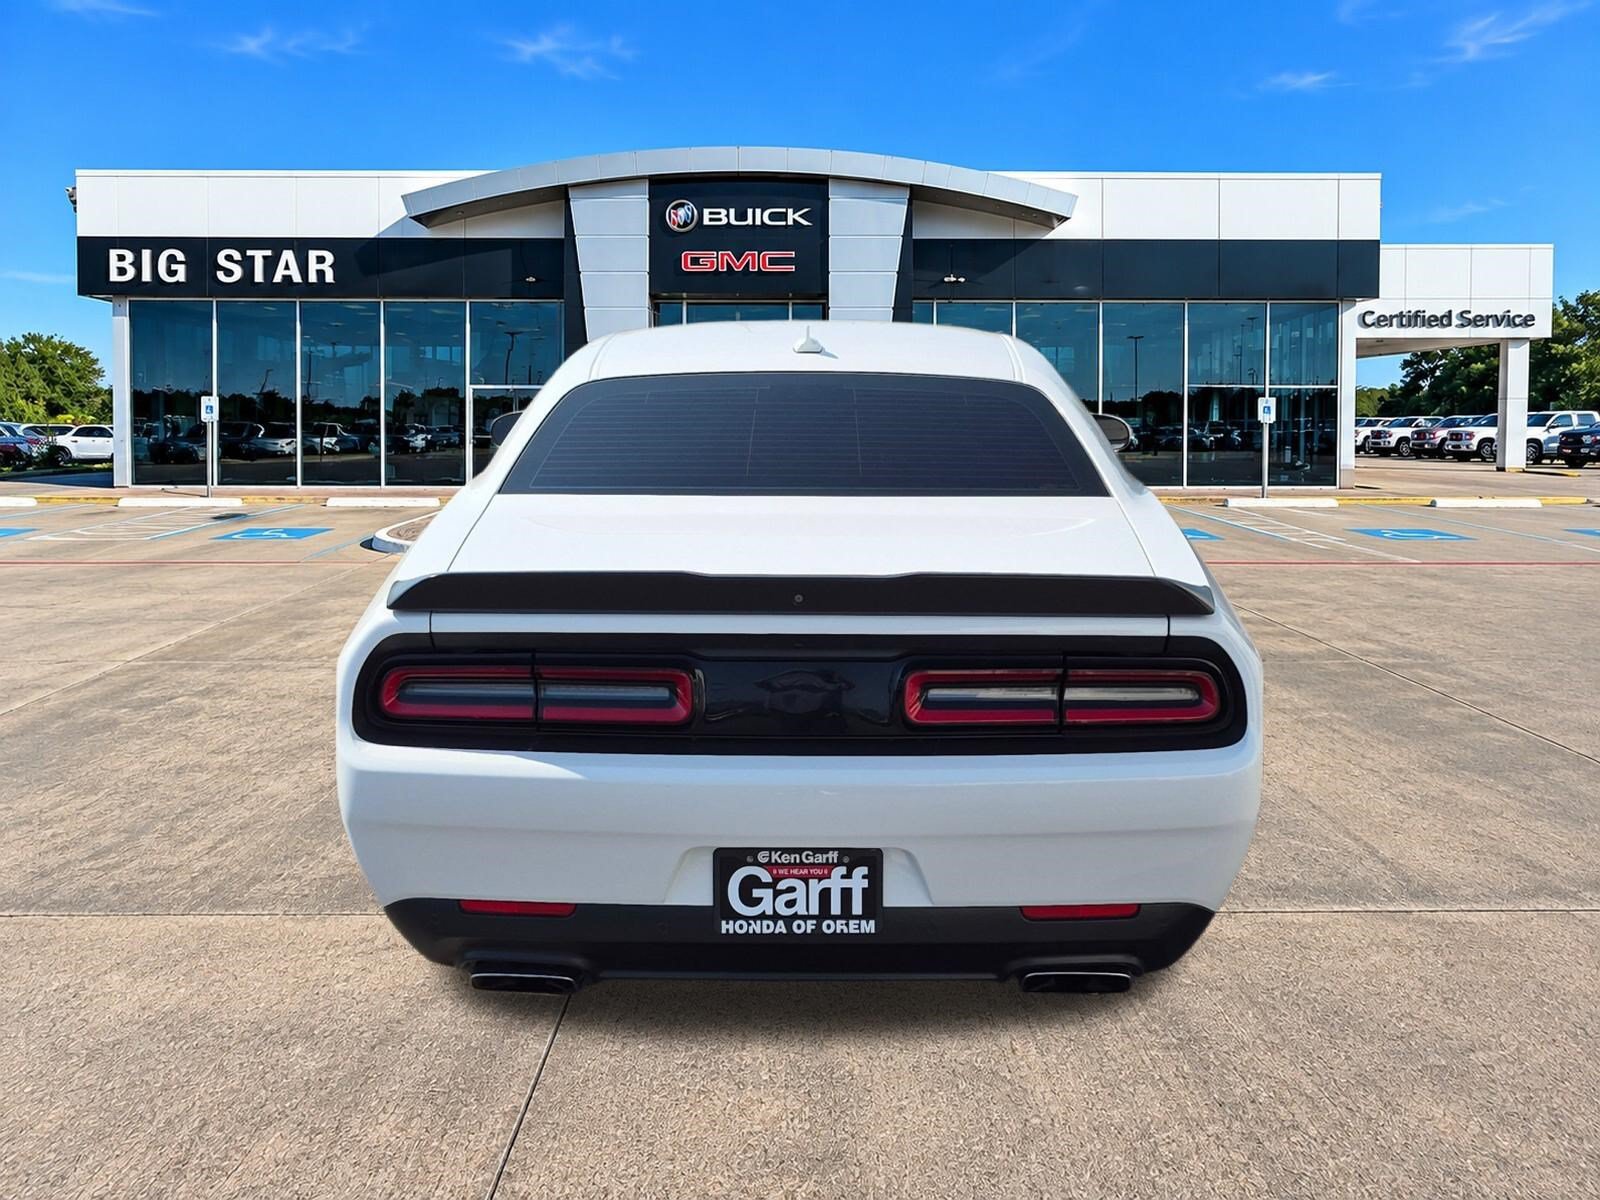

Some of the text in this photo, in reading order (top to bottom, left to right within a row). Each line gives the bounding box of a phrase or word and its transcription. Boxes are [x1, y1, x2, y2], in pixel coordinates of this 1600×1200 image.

[703, 208, 813, 226] BUICK
[108, 248, 336, 284] BIG STAR
[681, 251, 796, 272] GMC
[1360, 309, 1536, 329] Certified Service
[771, 850, 839, 864] Ken Garff
[727, 865, 869, 917] Garff
[721, 920, 876, 935] HONDA OF OREM
